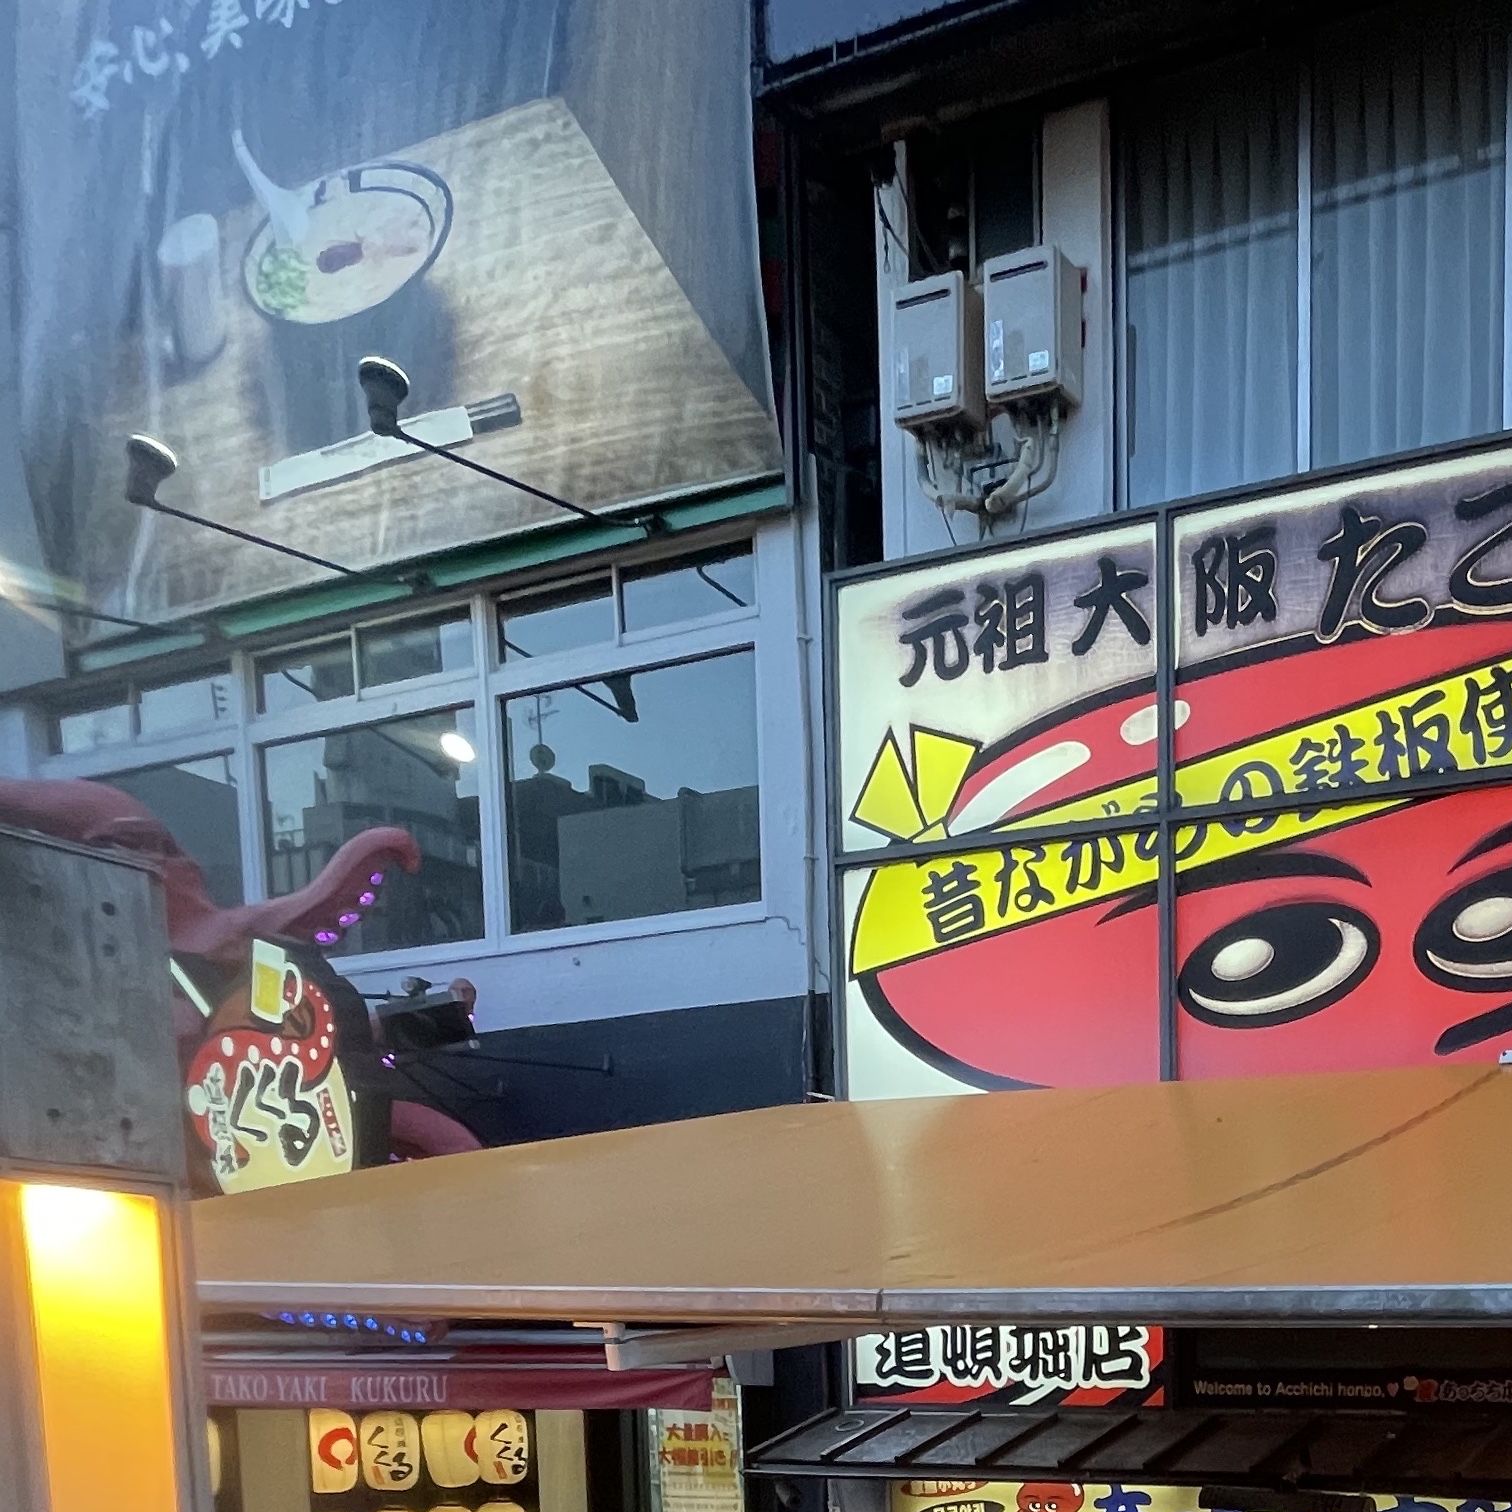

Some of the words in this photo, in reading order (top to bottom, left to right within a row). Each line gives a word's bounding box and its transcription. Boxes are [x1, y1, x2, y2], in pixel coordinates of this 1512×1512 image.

[351, 1375, 448, 1402] KUKURU
[1193, 1380, 1252, 1396] Welcome
[1257, 1381, 1271, 1396] to
[1275, 1381, 1334, 1398] Acchichi
